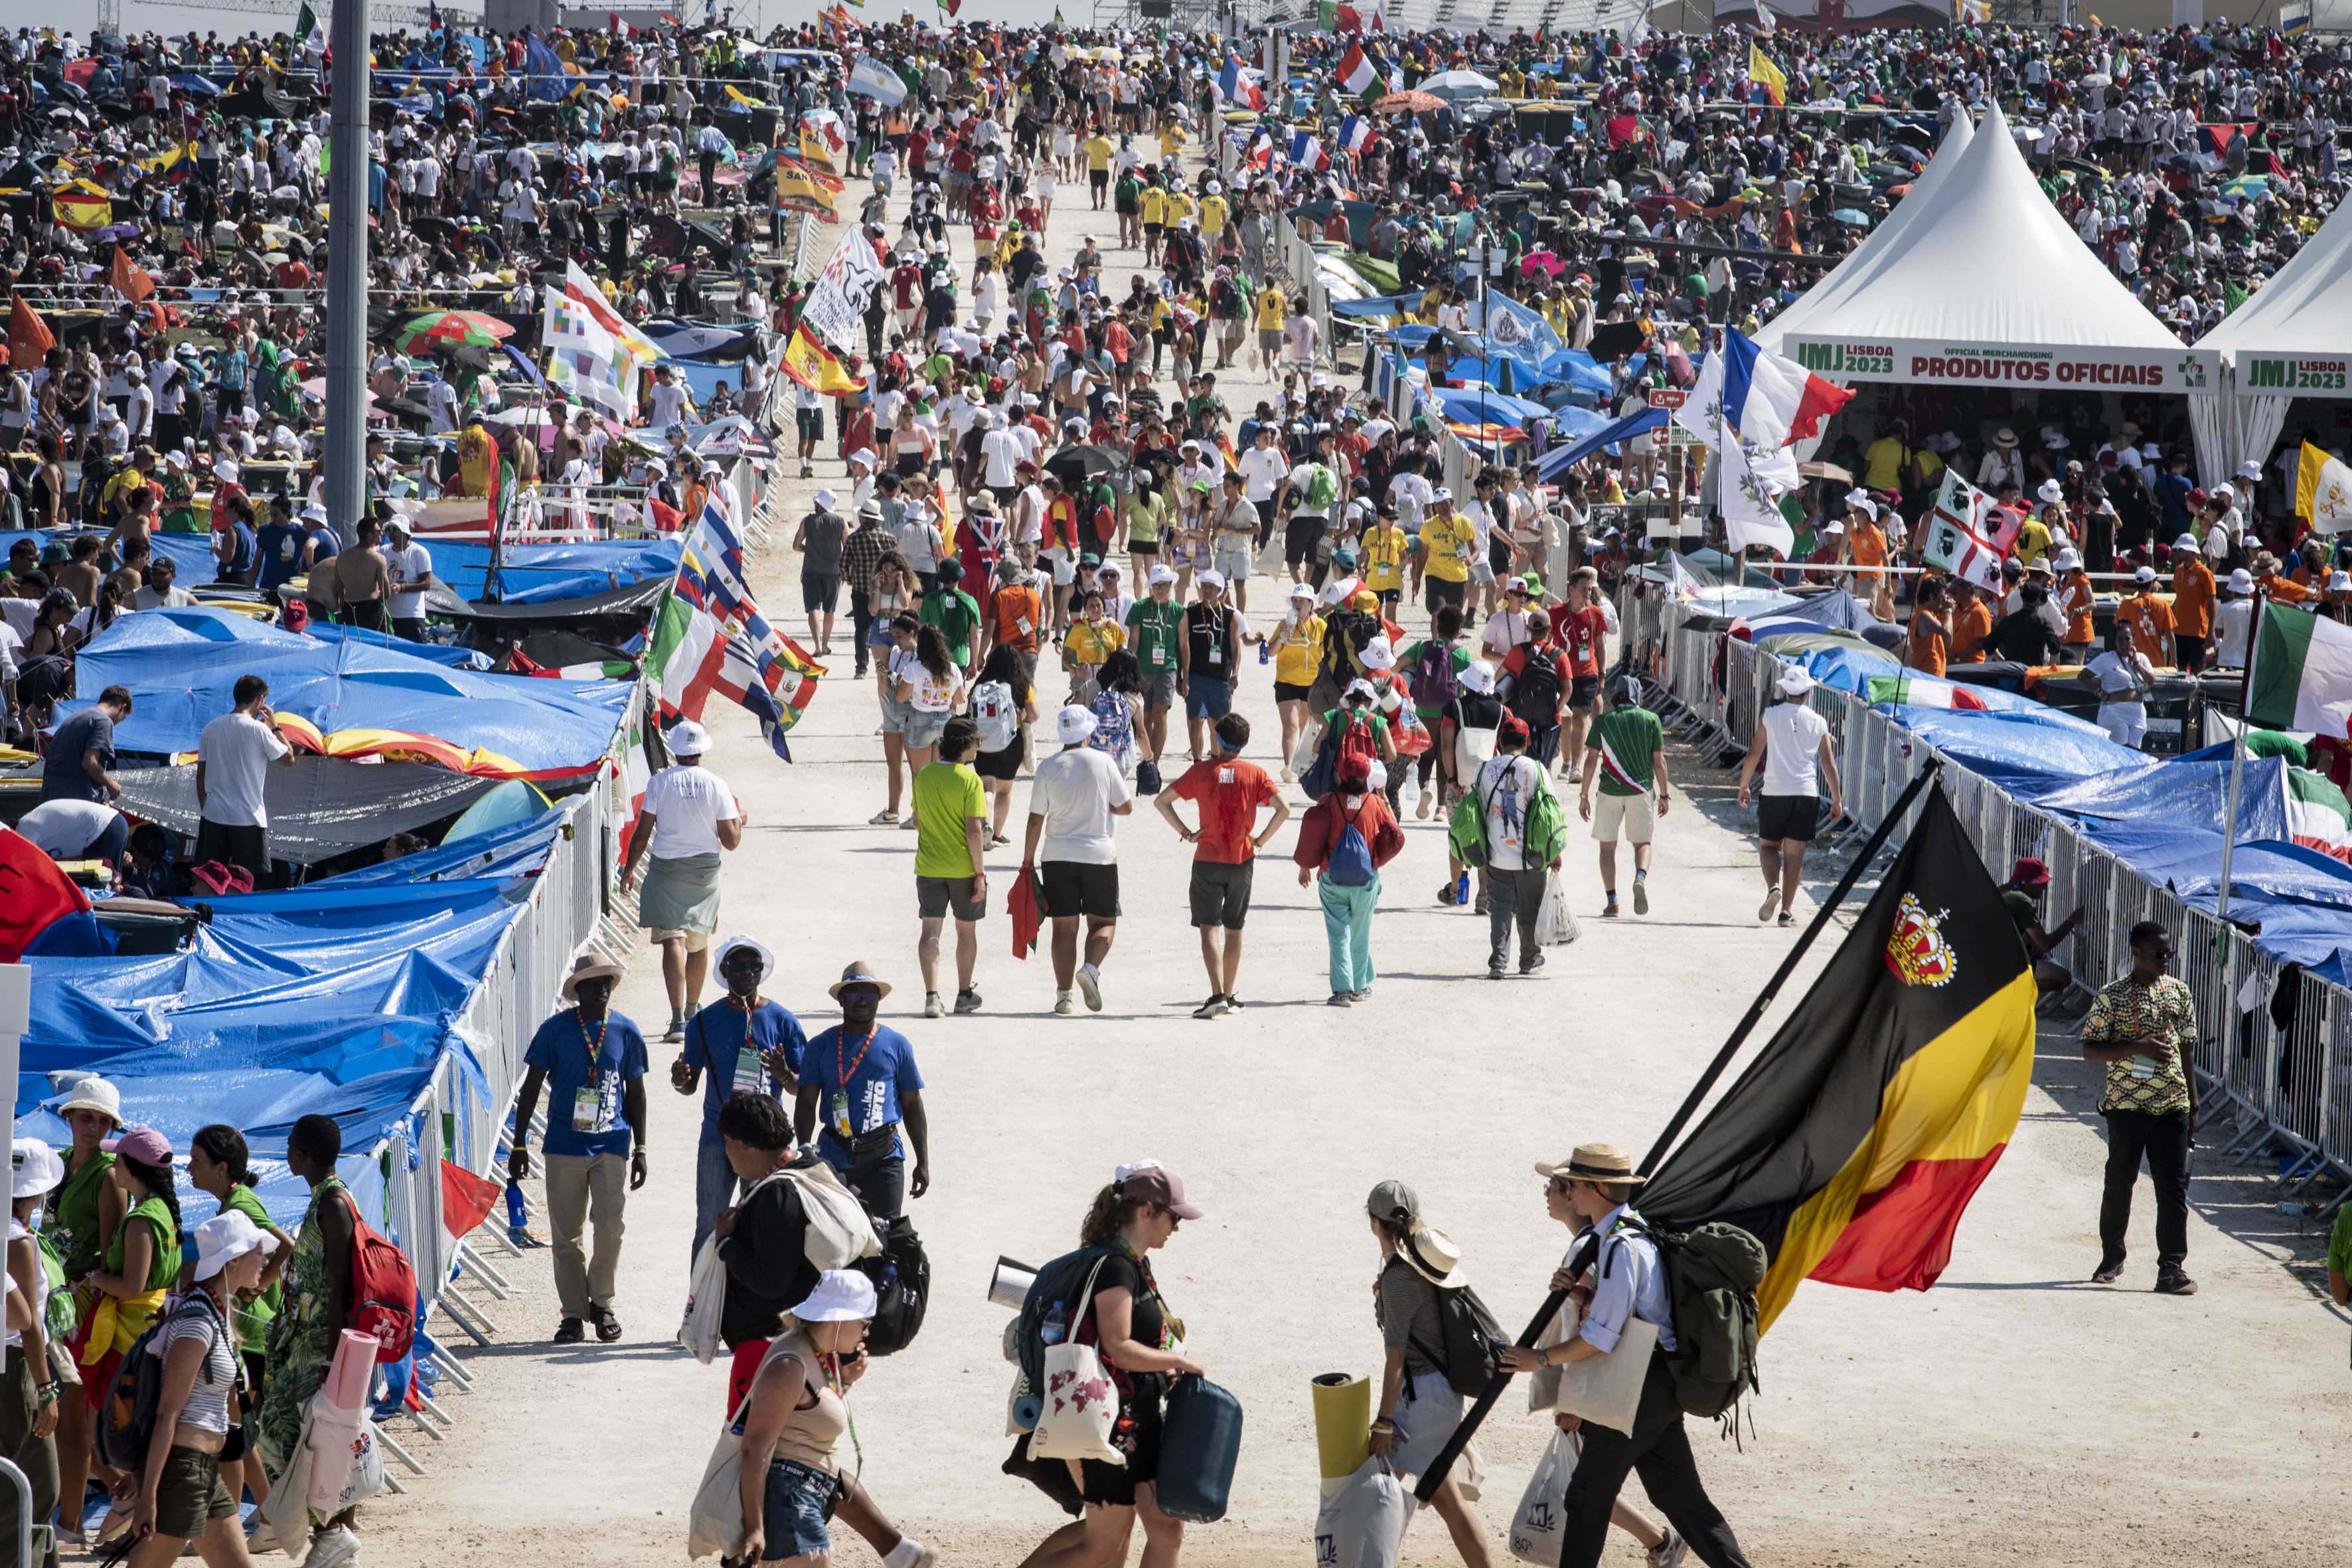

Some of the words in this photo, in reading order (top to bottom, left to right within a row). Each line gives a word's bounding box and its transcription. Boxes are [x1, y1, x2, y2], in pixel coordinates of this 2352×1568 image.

[1798, 343, 1844, 372] JMJ
[1845, 344, 1894, 356] LISBOA
[1944, 347, 1981, 356] OFFICIAL
[1982, 349, 2053, 359] MERCHANDISING
[1845, 356, 1894, 374] 2023
[1911, 356, 2050, 382] PRODUTOS
[2056, 362, 2163, 386] OFICIAIS
[2298, 360, 2346, 372] LISBOA
[2248, 360, 2296, 388] JMJ
[2298, 372, 2346, 389] 2023
